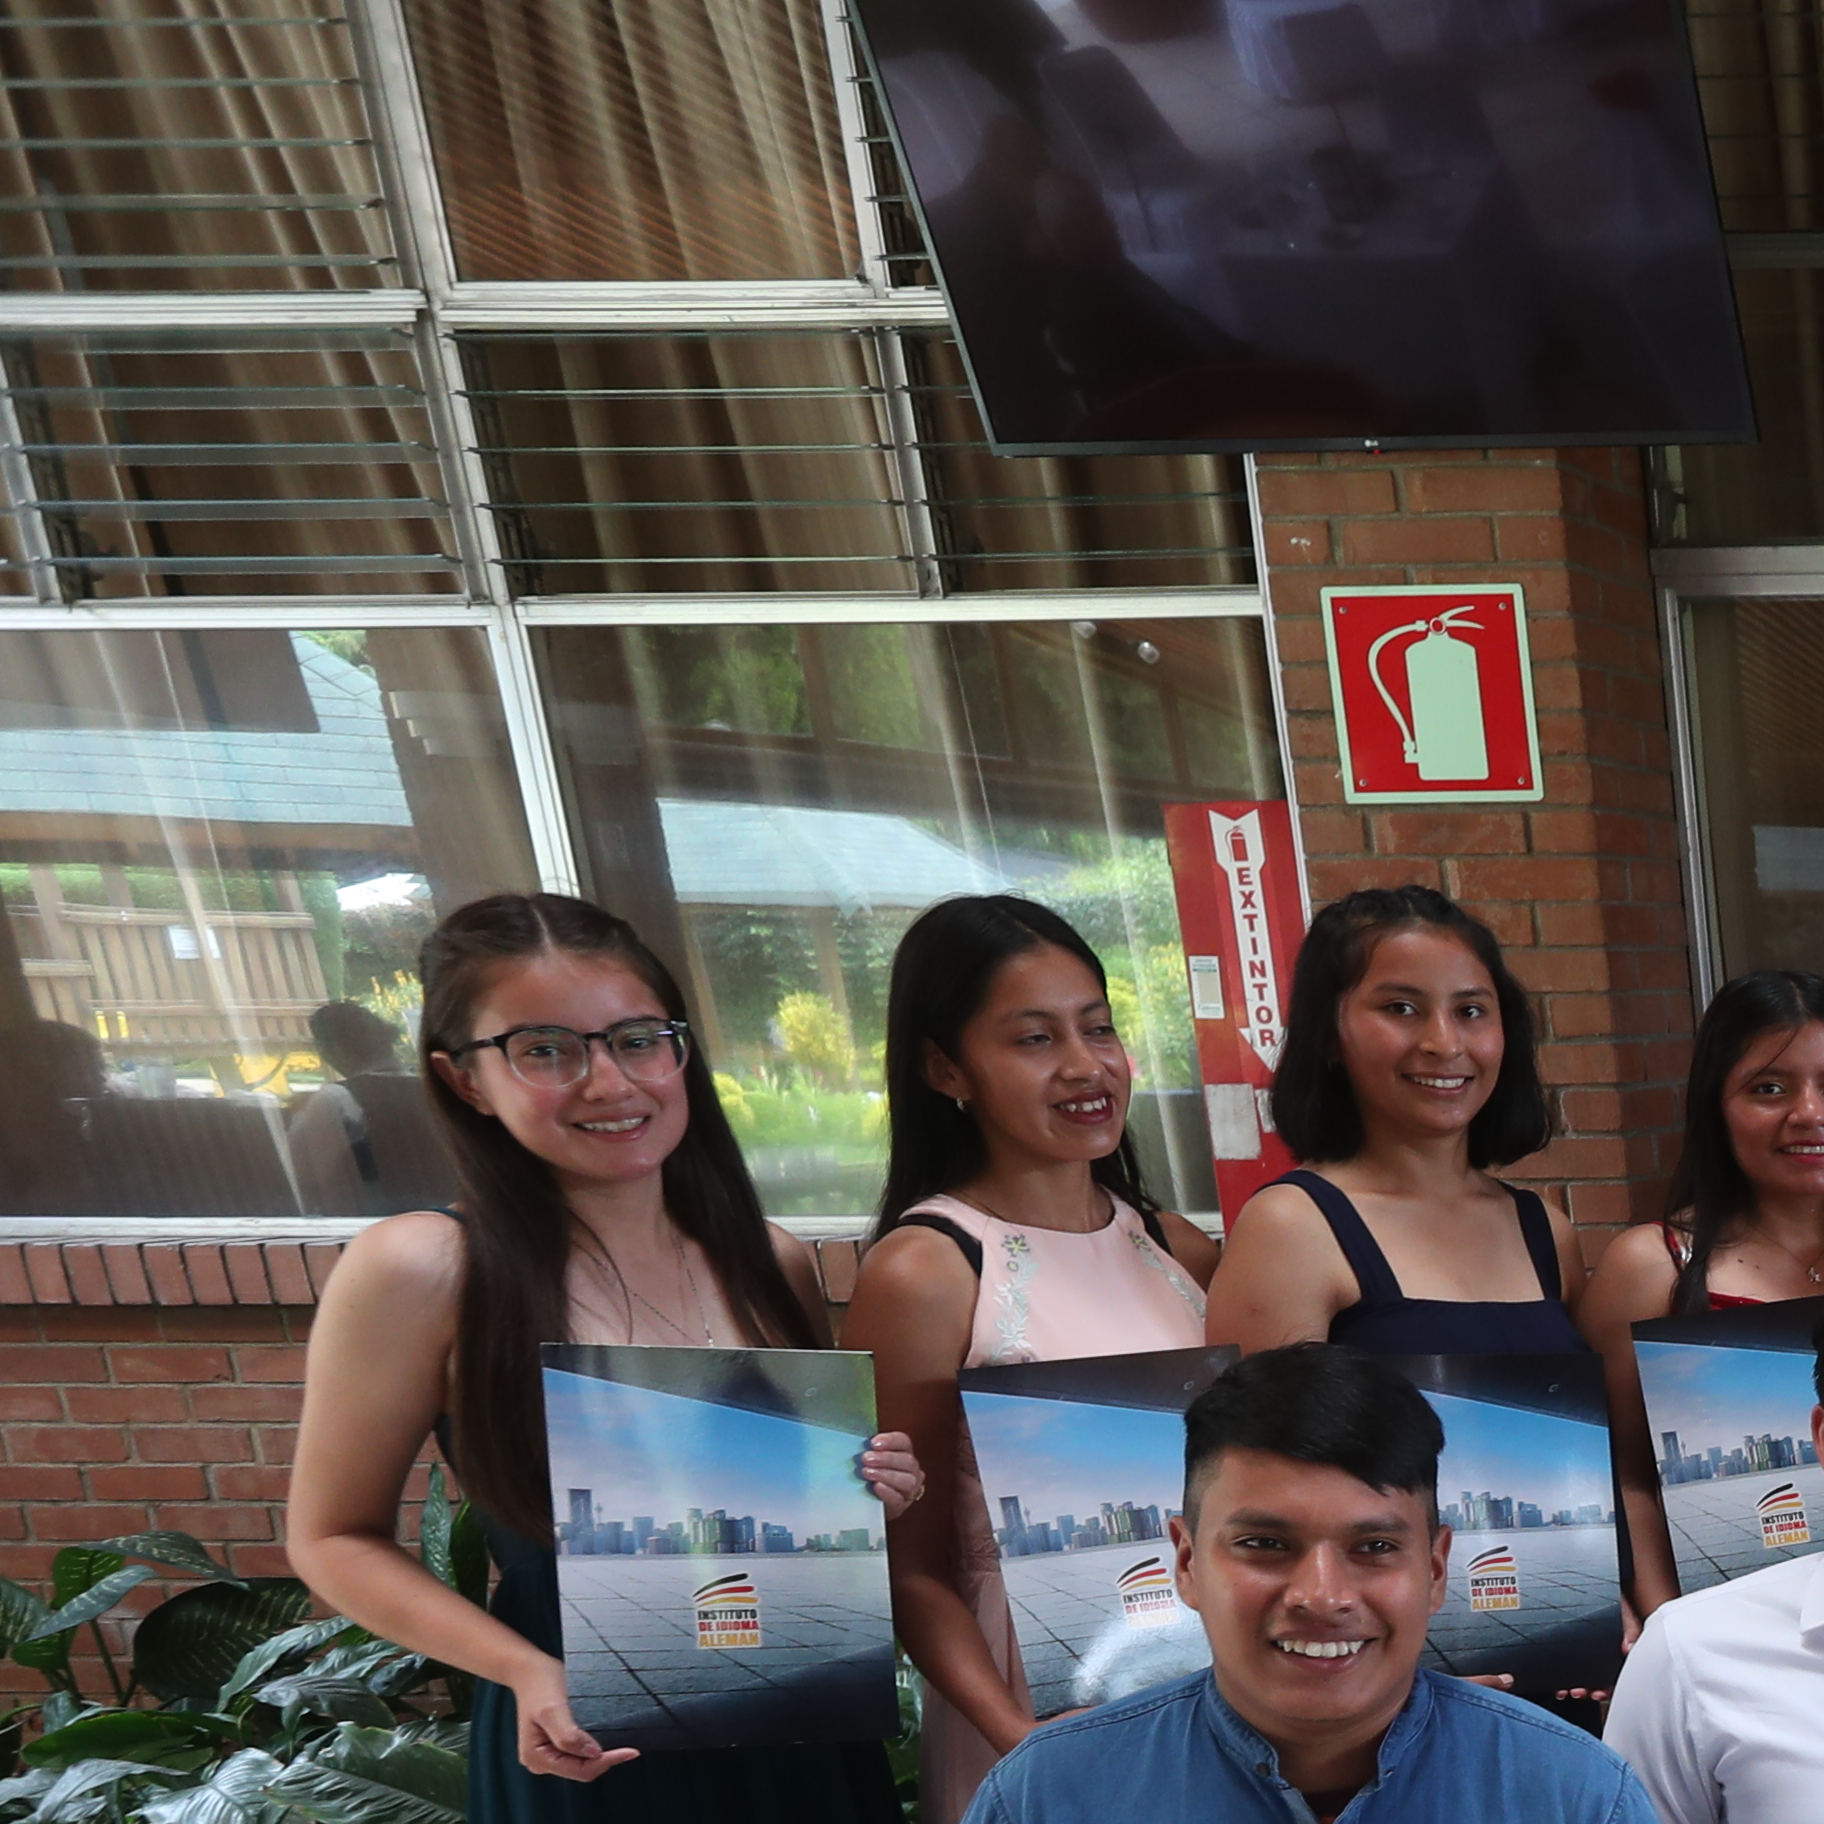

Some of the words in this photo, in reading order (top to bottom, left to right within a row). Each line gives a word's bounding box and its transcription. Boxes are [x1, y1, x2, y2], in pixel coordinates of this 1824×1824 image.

[1236, 866, 1277, 1047] EXTINTOR
[1761, 1511, 1804, 1525] INSTITUTO
[1763, 1525, 1774, 1534] DE
[1775, 1520, 1807, 1532] IDIOMA
[1471, 1576, 1516, 1587] INSTITUTO
[1122, 1589, 1174, 1604] INSTITUTO
[1472, 1588, 1483, 1597] DE
[1485, 1586, 1518, 1595] IDIOMA
[697, 1609, 758, 1620] INSTITUTO
[1125, 1603, 1138, 1615] DE
[698, 1621, 714, 1632] DE
[716, 1620, 760, 1631] IDIOMA
